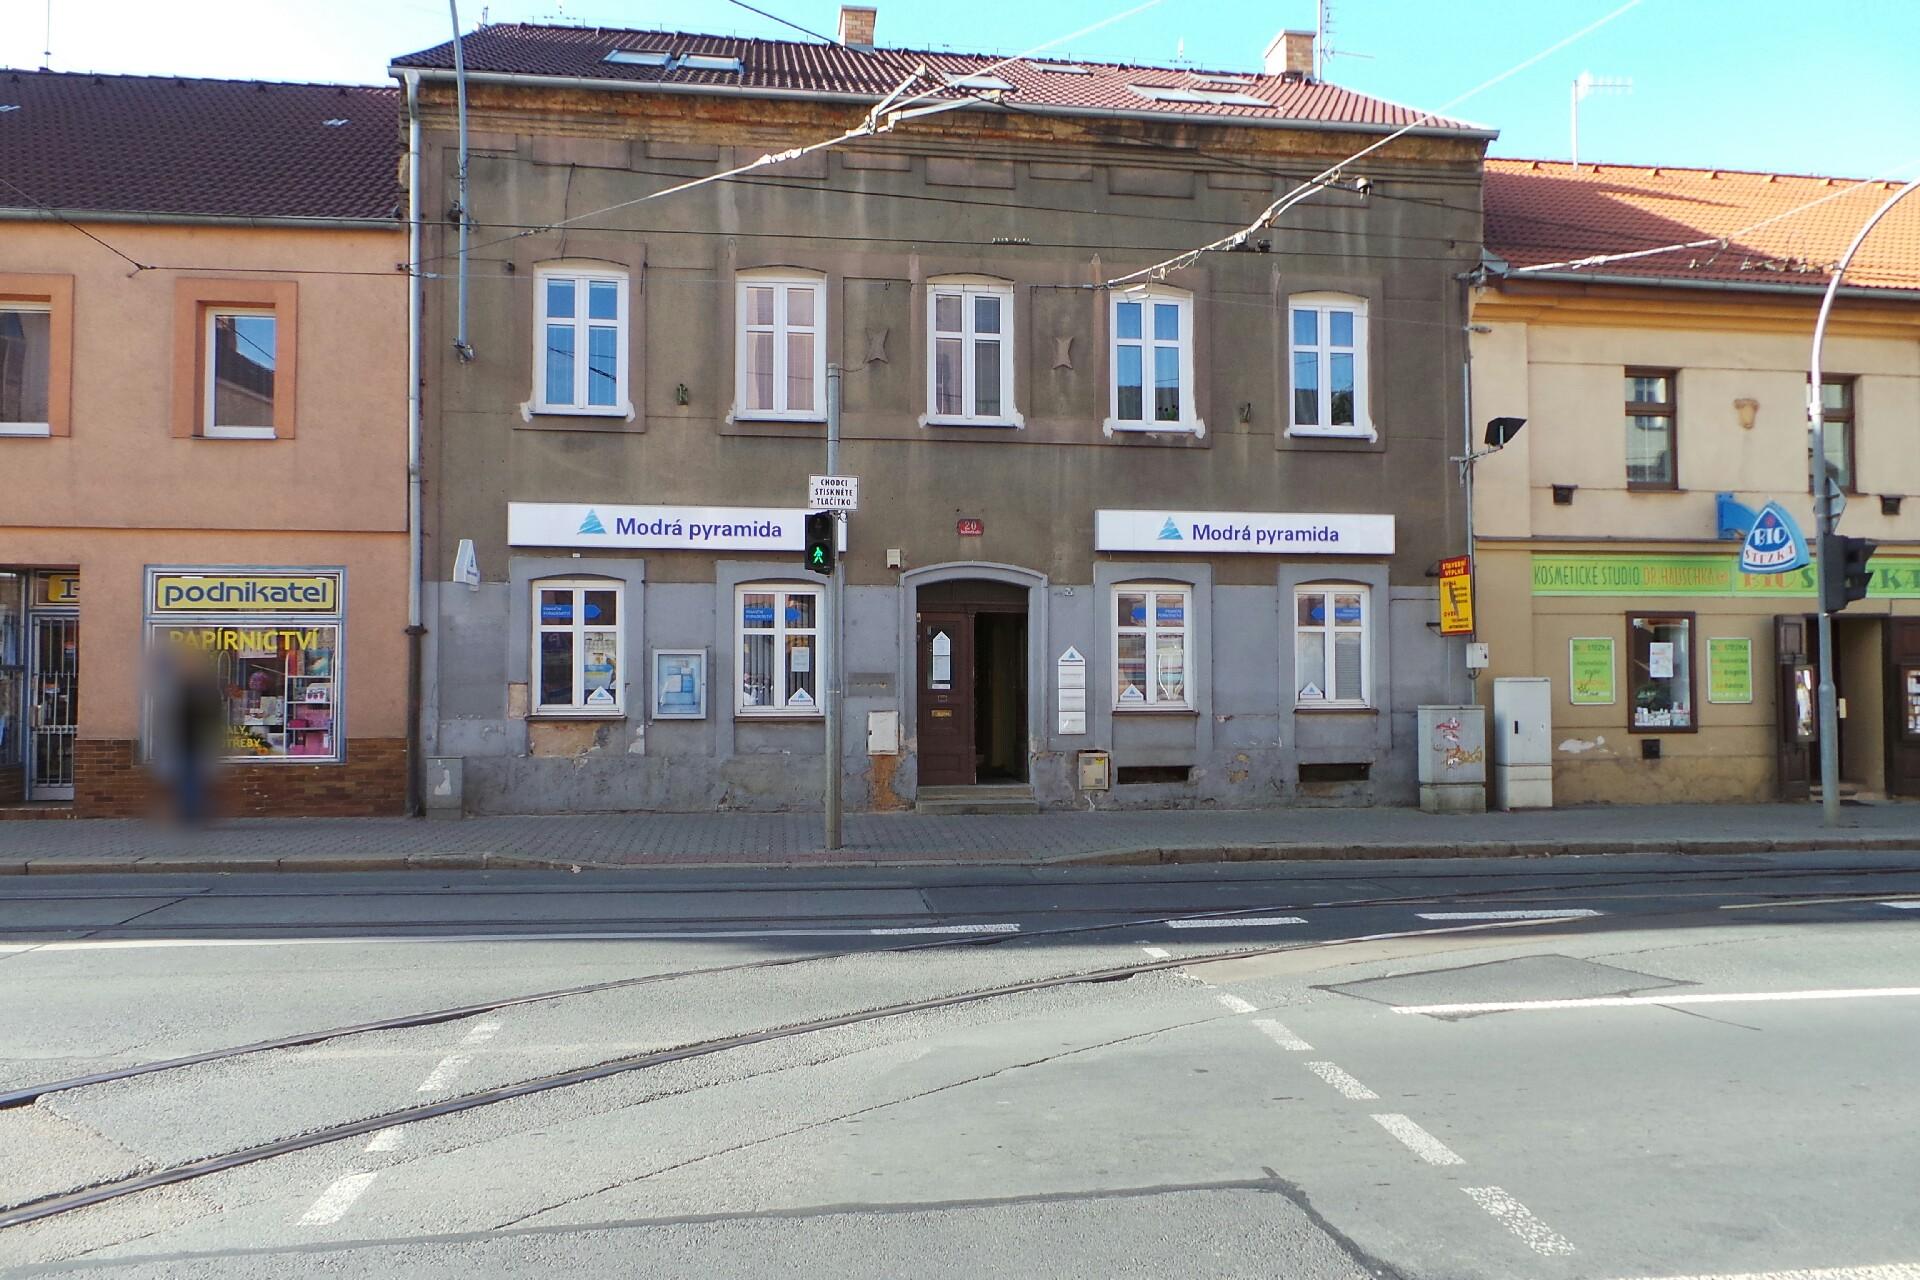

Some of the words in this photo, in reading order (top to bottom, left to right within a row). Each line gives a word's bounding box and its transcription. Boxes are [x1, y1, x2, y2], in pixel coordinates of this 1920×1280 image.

[820, 479, 848, 487] CHODCI
[817, 497, 851, 506] TLAČÍTKO
[616, 517, 683, 536] Modrá
[689, 520, 782, 540] pyramida
[964, 520, 977, 531] 20
[1192, 524, 1251, 541] Modrá
[1256, 526, 1339, 544] pyramida
[1752, 527, 1787, 546] BIO
[1534, 563, 1598, 585] KOSMETICKÉ
[1602, 566, 1640, 586] STUDIO
[164, 581, 327, 606] podnikatel
[168, 627, 319, 651] PAPÍRNICTVÍ
